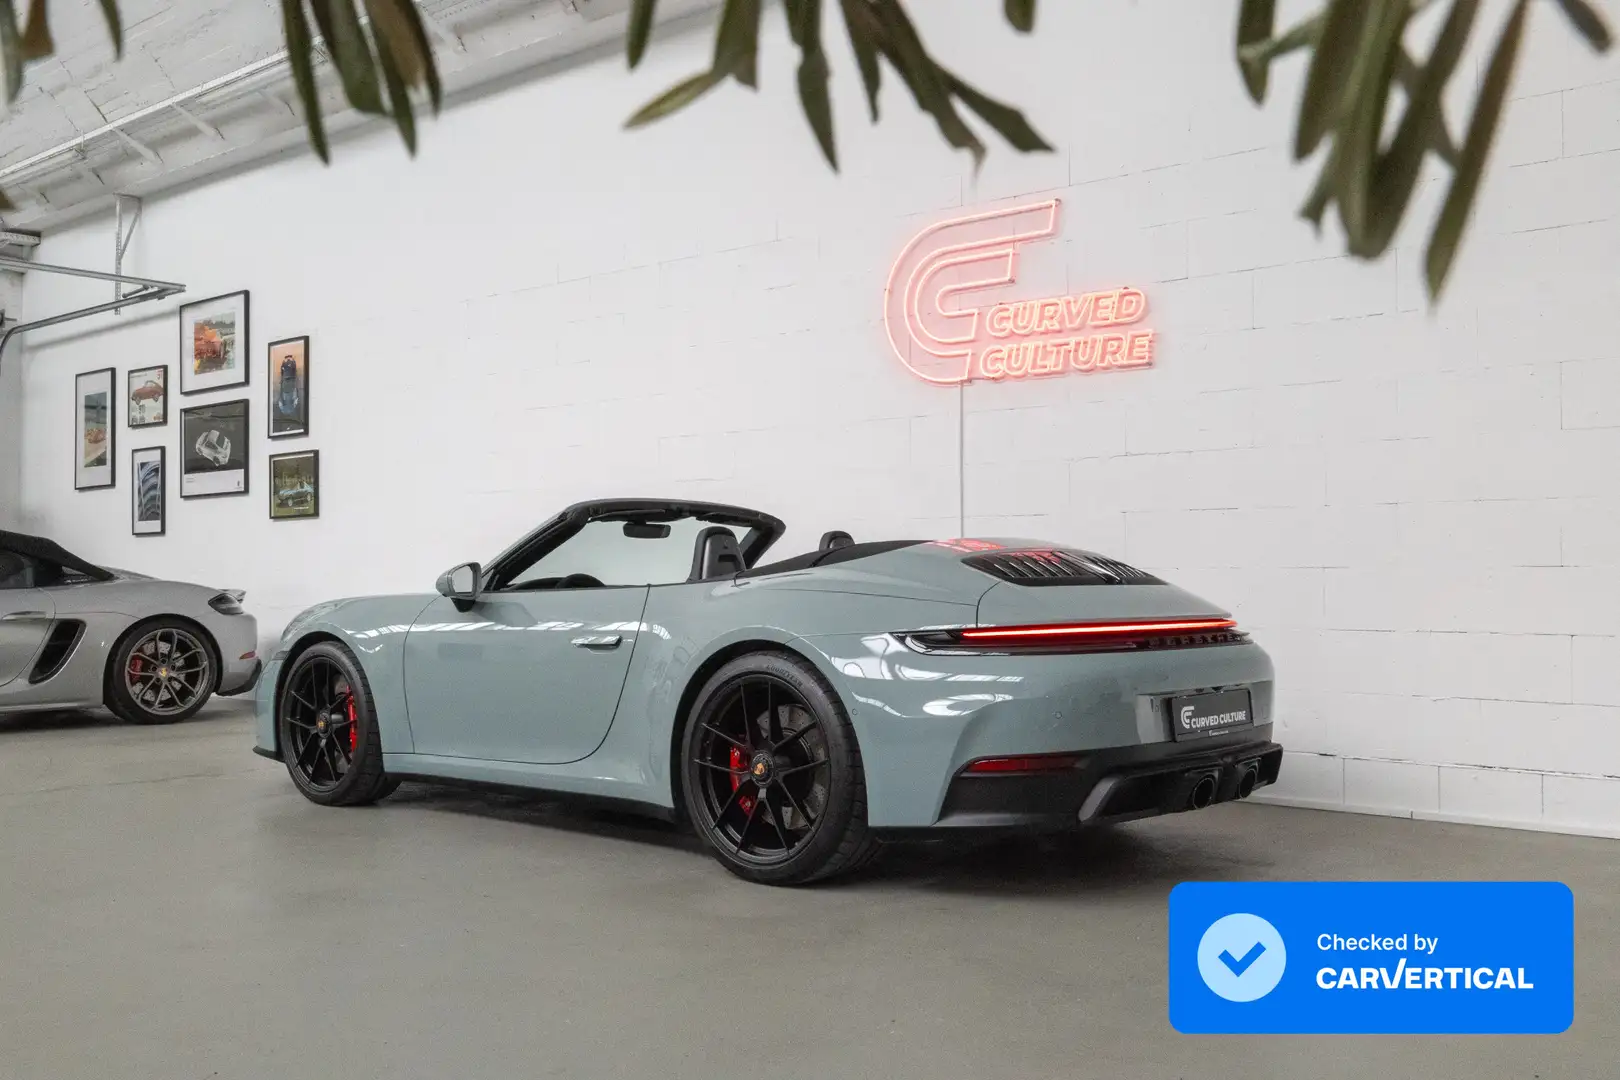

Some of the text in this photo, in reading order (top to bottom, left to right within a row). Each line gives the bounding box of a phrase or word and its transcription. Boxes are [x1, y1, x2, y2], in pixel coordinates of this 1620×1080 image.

[985, 288, 1146, 337] CURVED
[979, 329, 1153, 377] CULTURE
[1191, 711, 1246, 729] CURVED CULTURE
